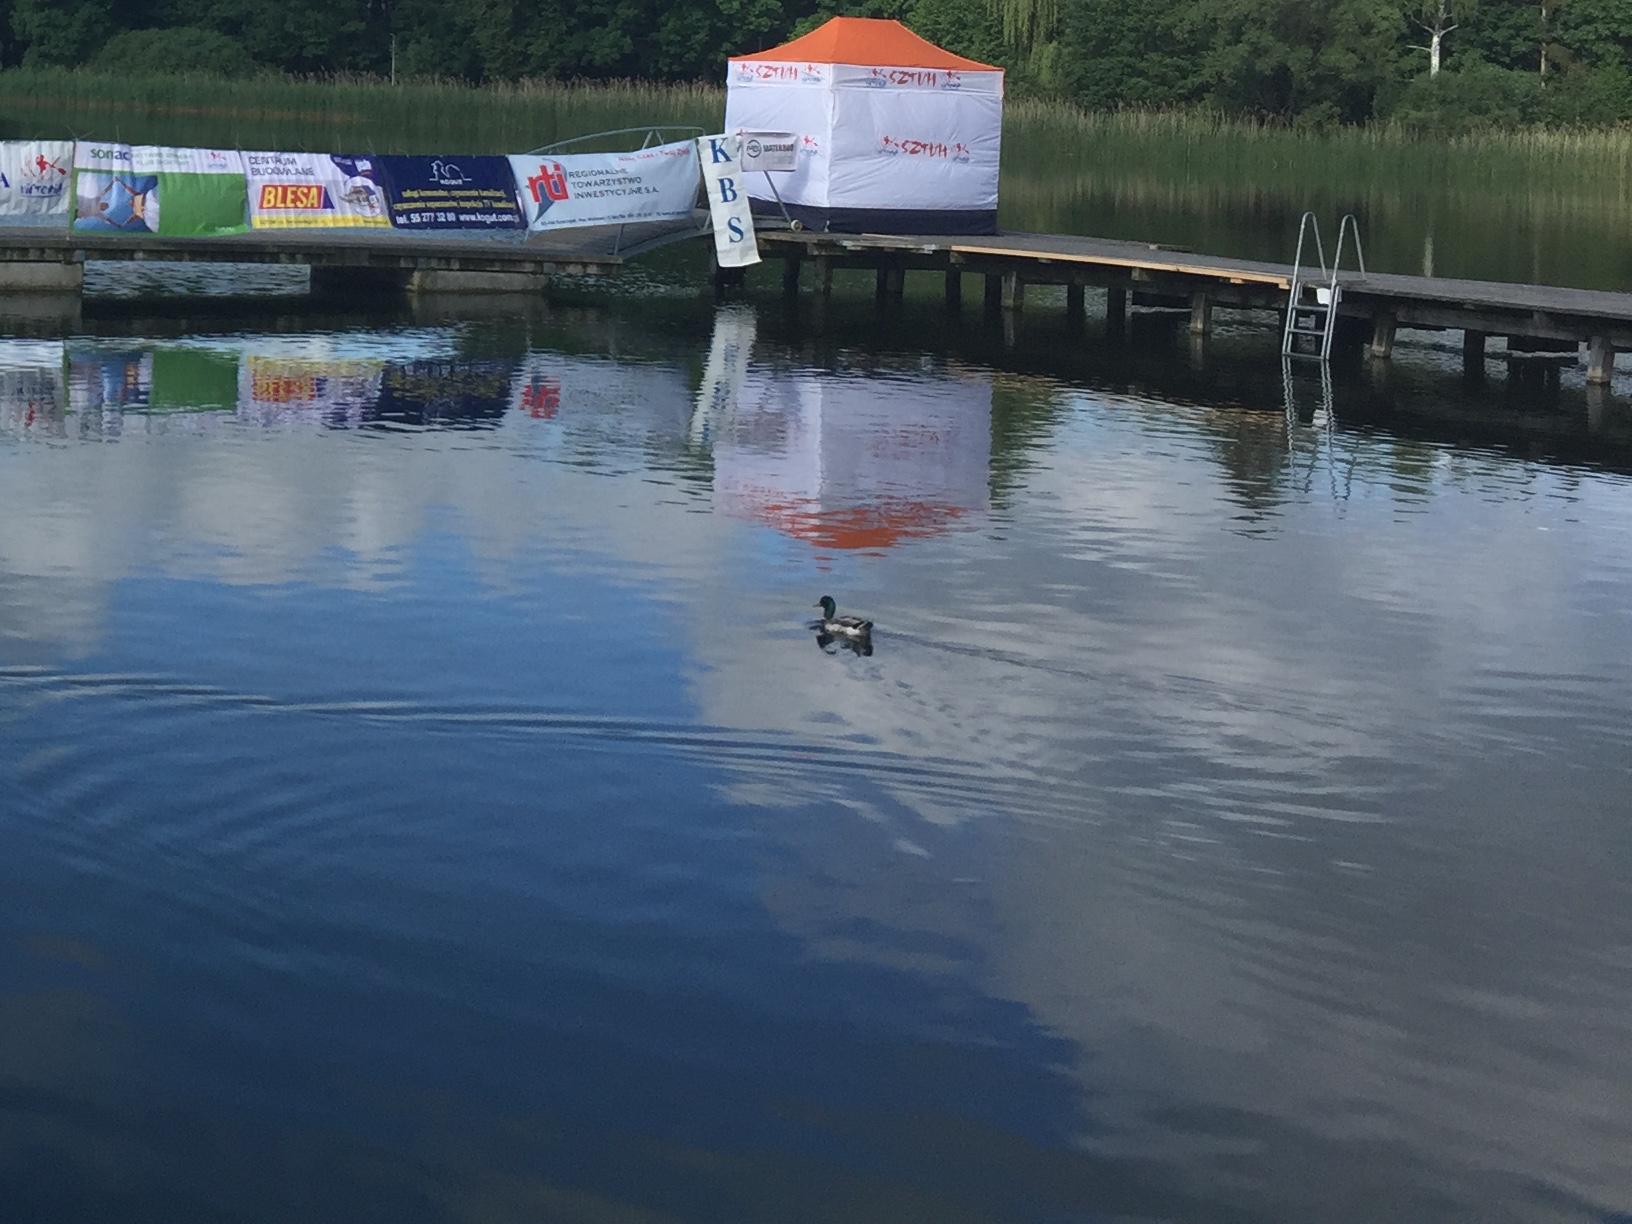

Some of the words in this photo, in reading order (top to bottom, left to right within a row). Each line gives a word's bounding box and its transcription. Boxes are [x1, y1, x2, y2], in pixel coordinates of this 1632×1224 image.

[90, 147, 131, 162] sonac
[248, 156, 297, 166] CENTRUM
[251, 167, 315, 176] BUDOWLANE
[568, 168, 629, 178] REGIONALNE
[527, 161, 569, 203] rti
[571, 176, 642, 188] TOWARZYSTWO
[262, 186, 319, 209] BLESA
[574, 187, 644, 200] INWESTYCYJNE
